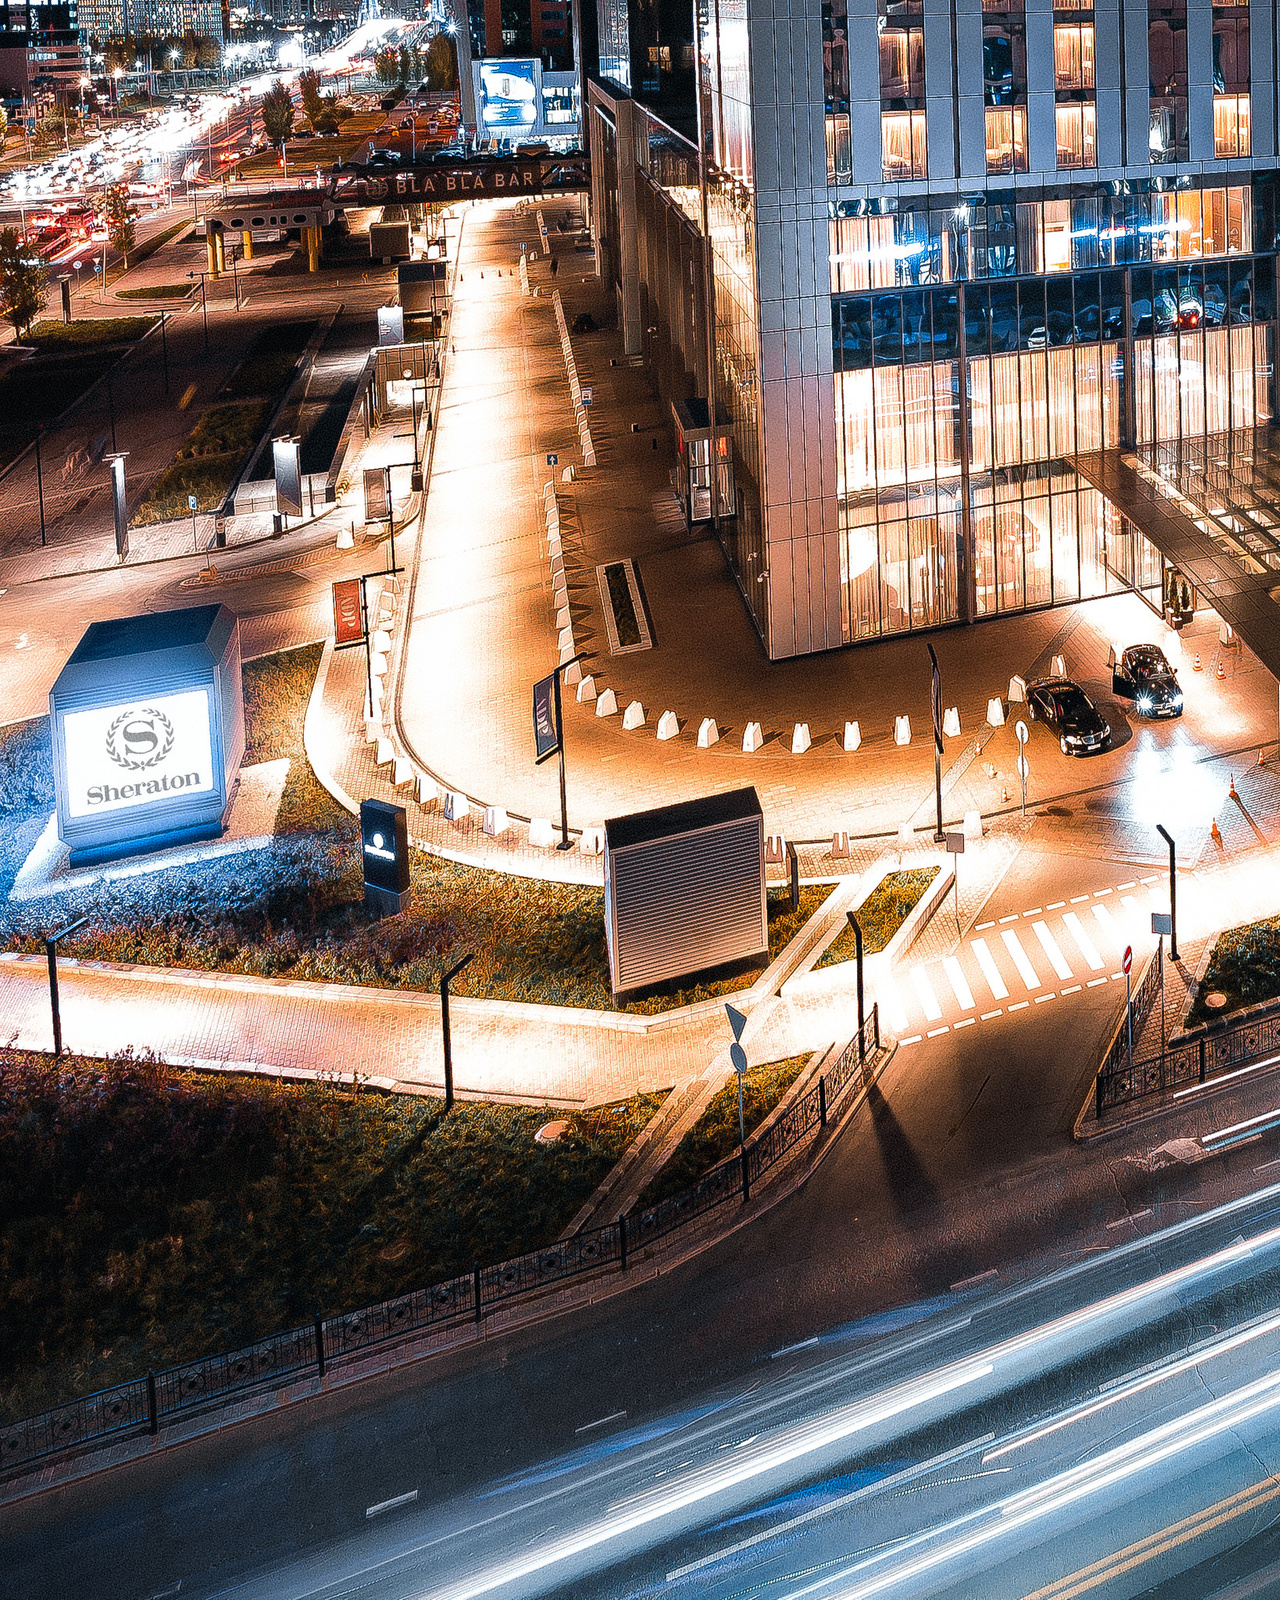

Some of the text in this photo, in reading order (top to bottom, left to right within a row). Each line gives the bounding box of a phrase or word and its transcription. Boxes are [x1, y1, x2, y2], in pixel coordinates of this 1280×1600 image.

[396, 178, 435, 194] BLA
[446, 175, 485, 191] BLA
[495, 172, 534, 188] BAR
[122, 719, 159, 756] S
[86, 771, 202, 806] Sheraton
